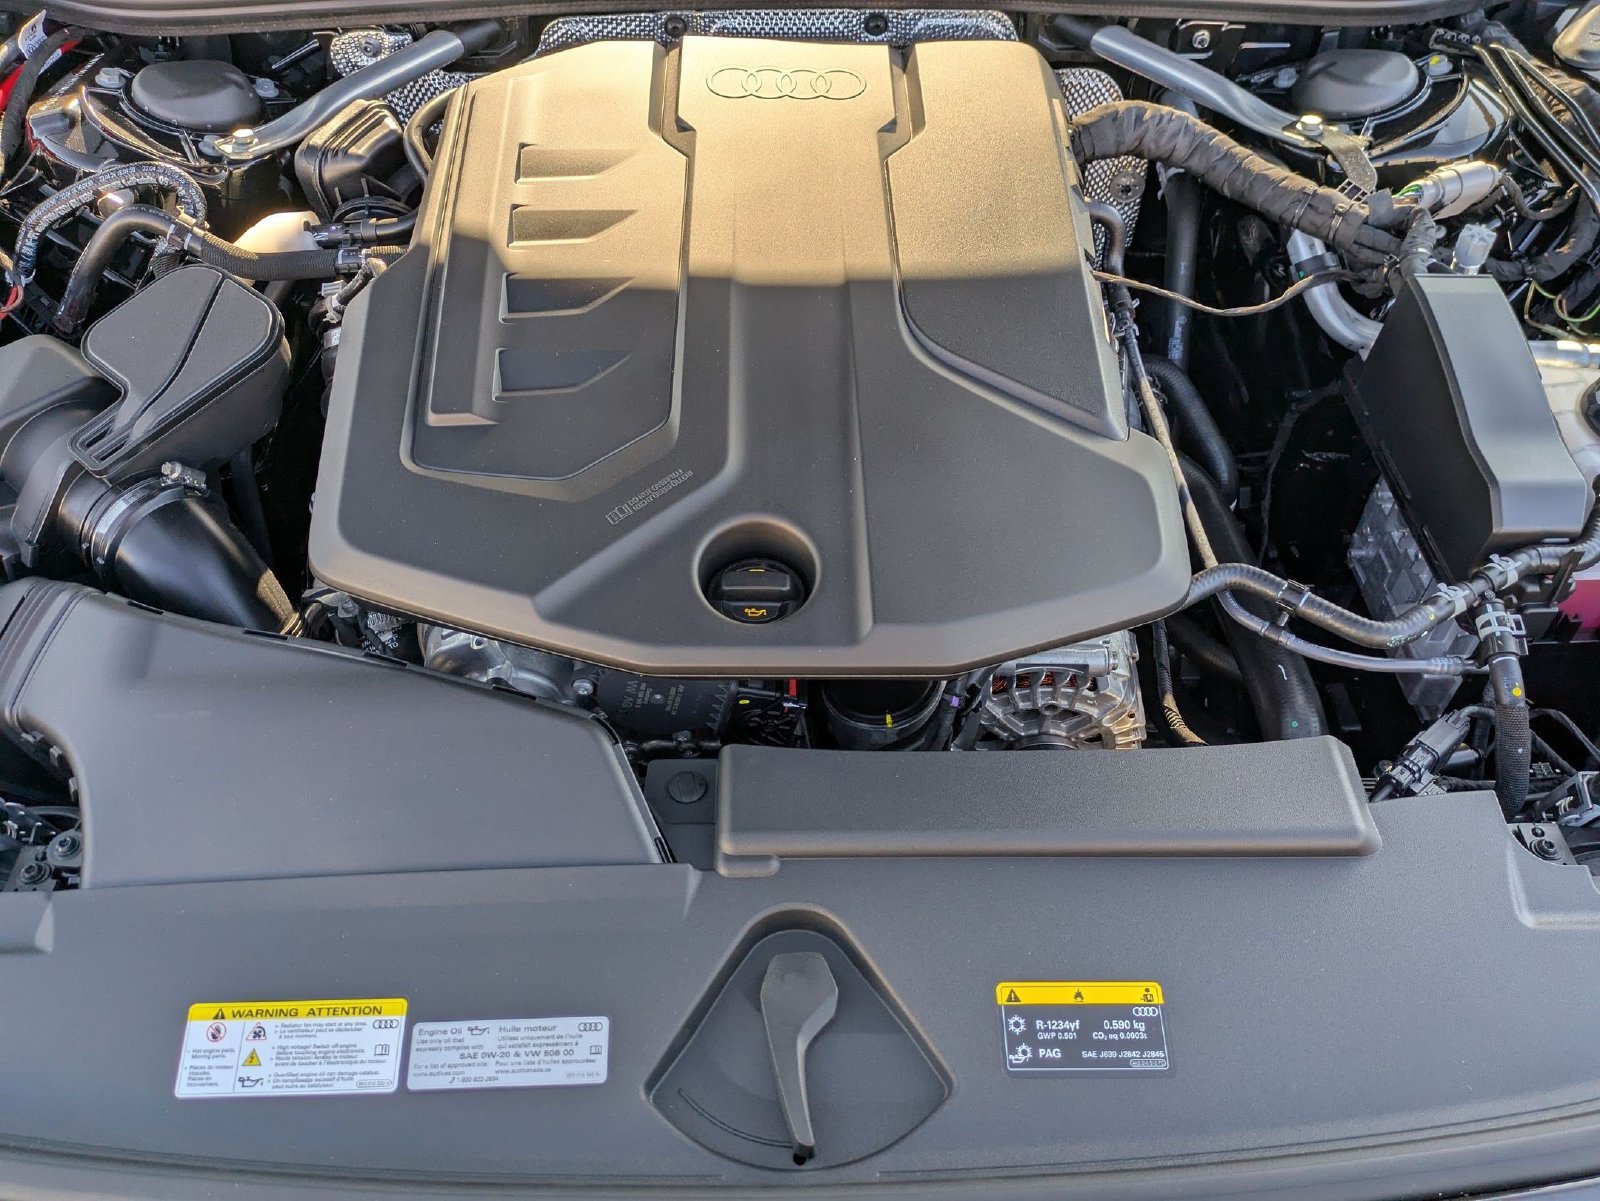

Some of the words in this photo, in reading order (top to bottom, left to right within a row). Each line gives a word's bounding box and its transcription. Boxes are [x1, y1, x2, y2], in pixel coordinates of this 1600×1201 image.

[232, 1008, 298, 1018] WARNING
[307, 1006, 382, 1016] ATTENTION
[1036, 1020, 1080, 1031] R-1234yf
[1104, 1020, 1131, 1030] 0.590
[1133, 1020, 1145, 1031] kg
[418, 1028, 448, 1036] Engine
[481, 1051, 510, 1059] 0W-20
[1039, 1048, 1062, 1058] PAG
